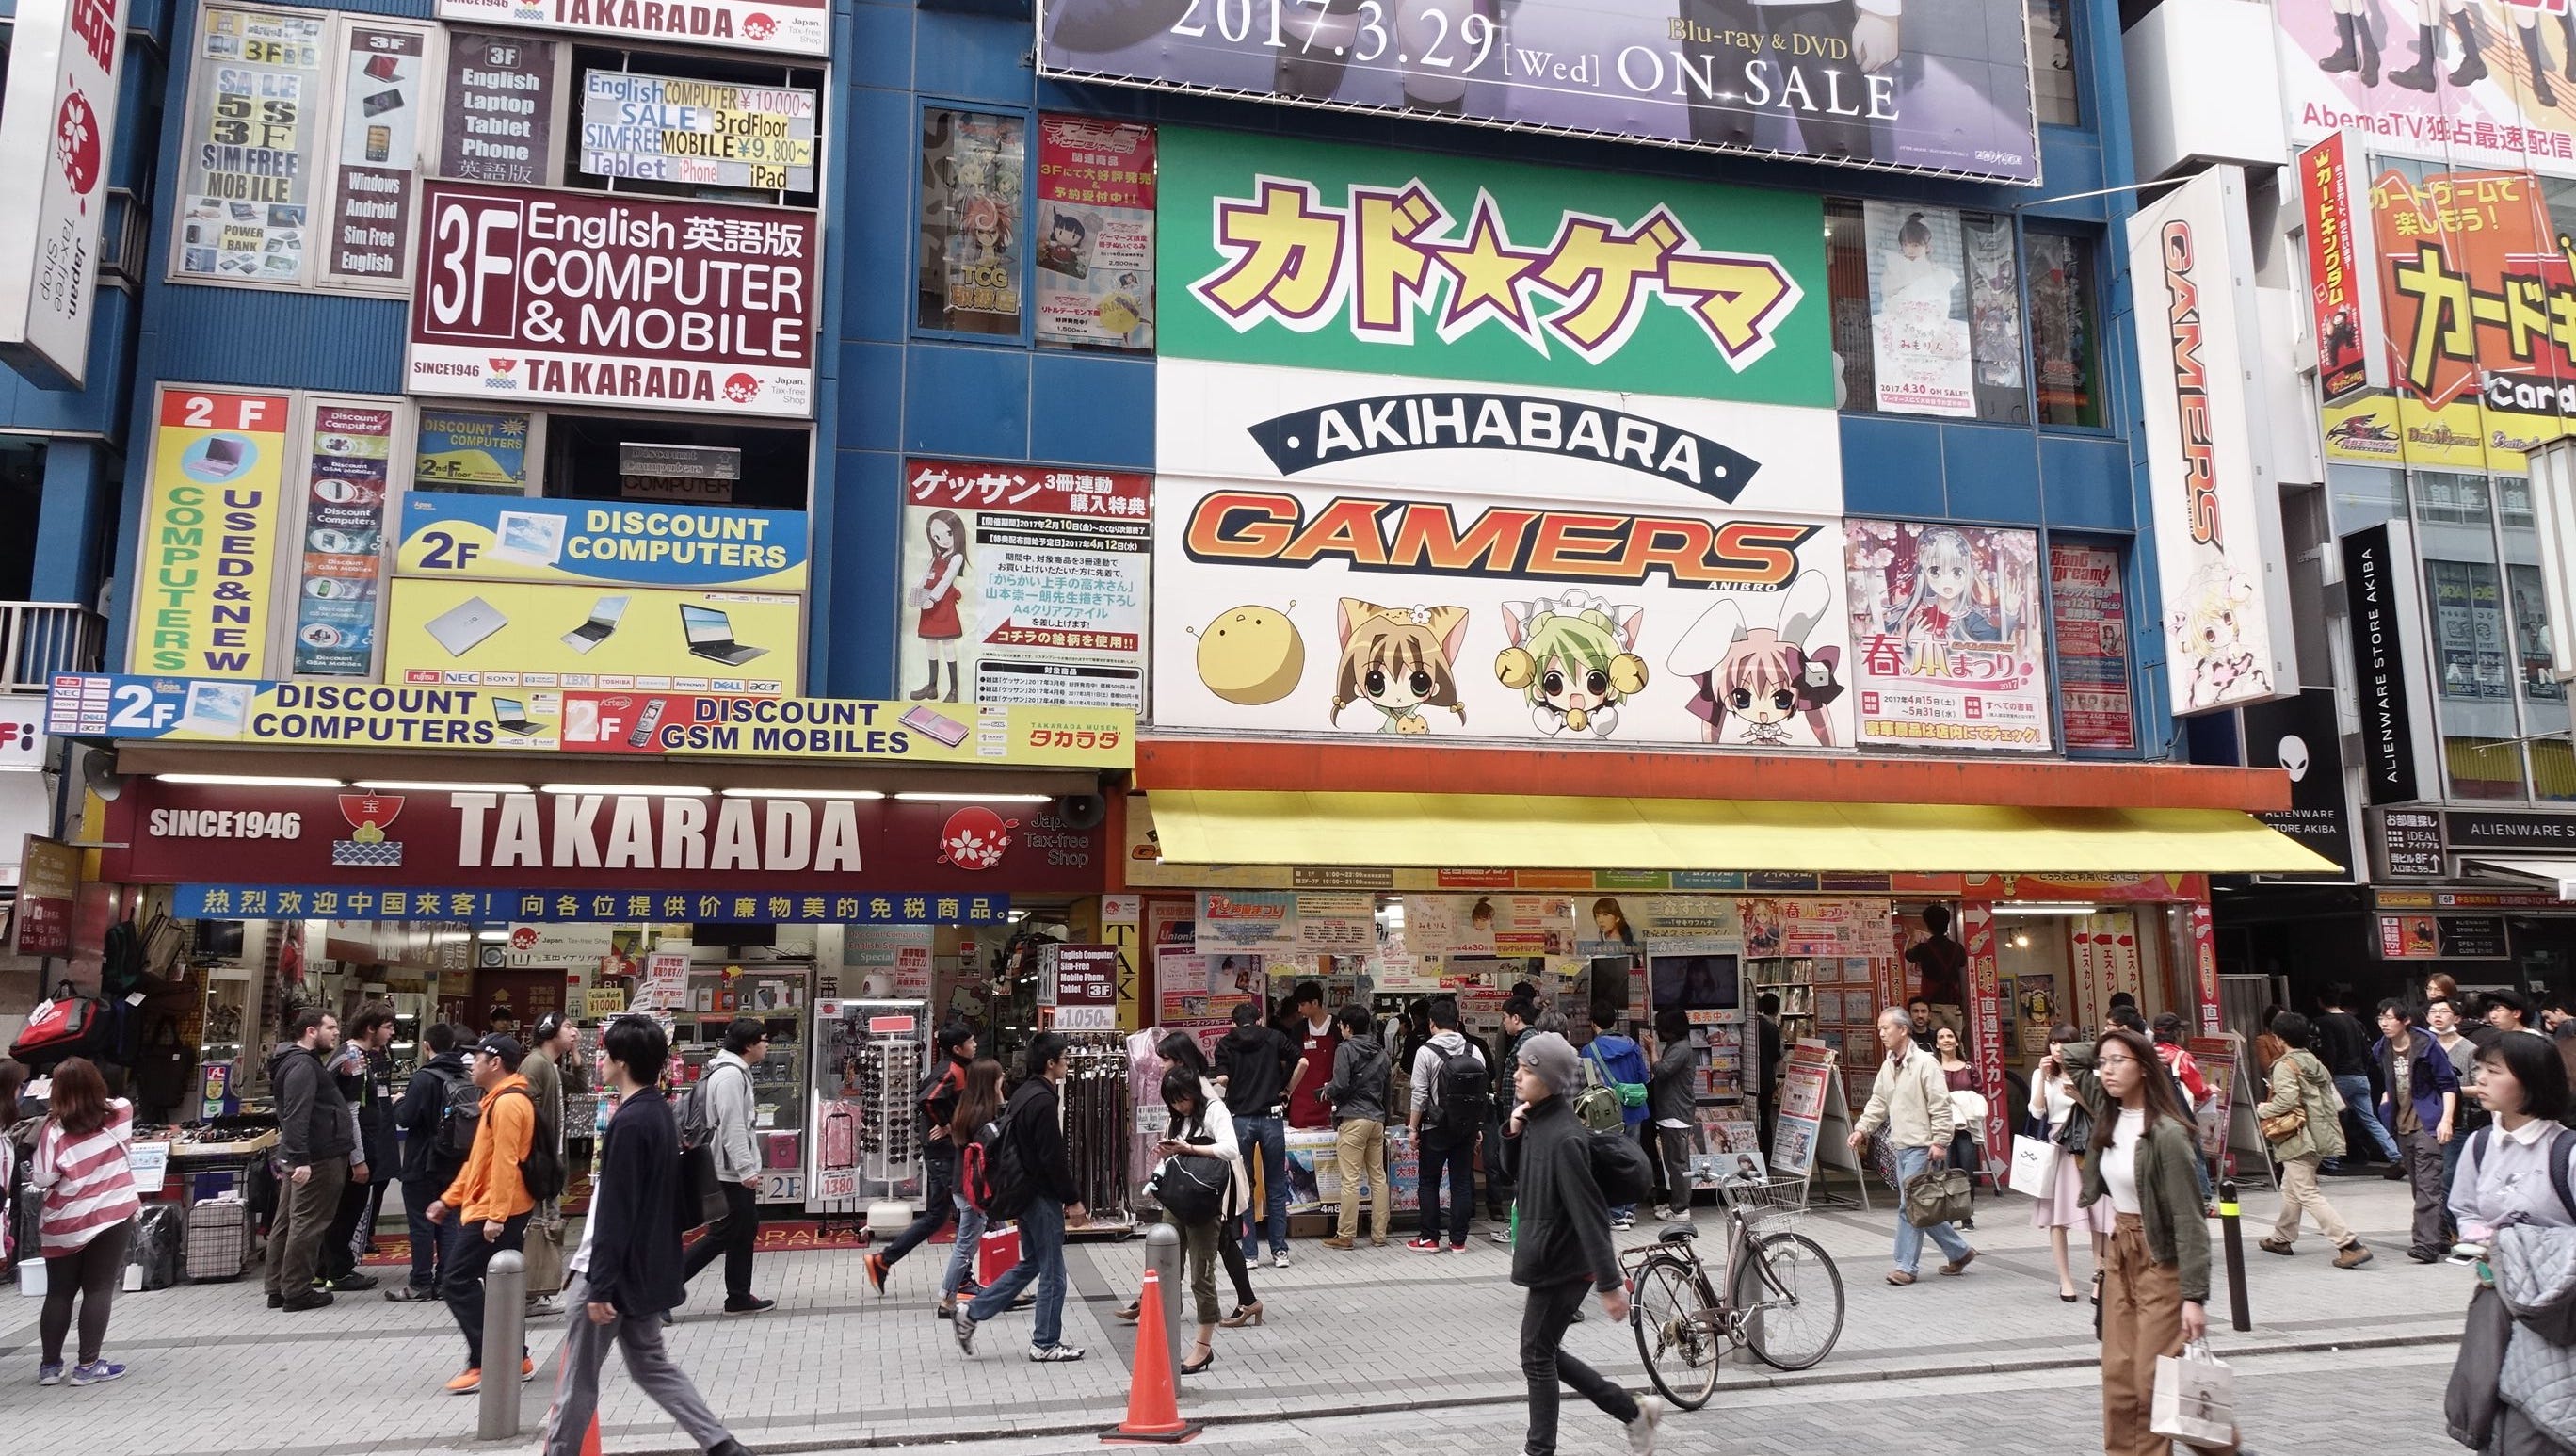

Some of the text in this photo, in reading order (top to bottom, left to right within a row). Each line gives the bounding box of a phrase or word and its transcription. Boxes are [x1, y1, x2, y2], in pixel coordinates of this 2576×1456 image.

[554, 0, 734, 39] TAKARADA
[791, 17, 822, 27] Japan.
[369, 35, 407, 50] 3F
[789, 26, 821, 38] Tax-free
[799, 35, 822, 45] Shop
[1667, 16, 1848, 60] Blu-ray & DVD
[489, 45, 516, 65] 3F
[218, 69, 298, 97] SALE
[462, 67, 539, 92] English
[1504, 43, 1600, 87] [Wed]
[1617, 44, 1716, 100] ON
[1744, 58, 1901, 122] SALE
[463, 90, 535, 117] Laptop
[588, 73, 738, 111] English COMPUTER
[464, 115, 531, 138] Tablet
[621, 104, 789, 138] SALE 3rd Floor
[462, 138, 529, 161] Phone
[661, 134, 735, 158] MOBILE
[457, 159, 533, 185] 英語版
[589, 152, 787, 189] Tablet iPhone iPad
[205, 172, 289, 203] MOBILE
[348, 171, 401, 194] Windows
[2368, 178, 2520, 211] カードゲームで
[346, 198, 398, 220] Android
[224, 223, 264, 238] POWER
[344, 225, 395, 248] Sim Free
[527, 202, 804, 258] English 英語版
[2315, 168, 2345, 308] カードキングダム
[226, 238, 258, 253] BANK
[40, 238, 61, 302] Shop
[341, 251, 394, 274] English
[431, 202, 520, 328] 3F
[523, 246, 802, 314] COMPUTER
[961, 264, 1008, 288] TCG
[522, 299, 803, 359] & MOBILE
[413, 361, 480, 378] SINCE1946
[523, 358, 716, 402] TAKARADA
[770, 386, 807, 397] Tax-free
[774, 376, 806, 387] Japan.
[1879, 382, 1926, 396] 2017.4.30
[1929, 387, 1942, 396] ON
[2161, 218, 2224, 555] GAMERS
[782, 395, 807, 406] Shop
[324, 420, 383, 431] Computers
[330, 412, 378, 423] Discount
[424, 419, 494, 437] DISCOUNT
[449, 434, 523, 449] COMPUTERS
[1315, 397, 1702, 484] AKIHABARA
[911, 467, 1114, 506] ゲッサン 3冊連動
[323, 507, 371, 517] Discount
[1070, 493, 1147, 517] 購入特典
[316, 515, 376, 526] Computers
[586, 510, 770, 541] DISCOUNT
[418, 531, 481, 570] 2F
[1183, 490, 1821, 591] GAMERS
[567, 537, 788, 569] COMPUTERS
[152, 486, 205, 671] COMPUTERS
[1707, 580, 1779, 593] ANIBRO
[1012, 604, 1108, 620] A4クリアファイル
[315, 654, 353, 662] Discount
[2360, 547, 2399, 784] ALIENWARE STORE AKIBA
[444, 671, 479, 684] NEC
[486, 673, 517, 684] SONY
[565, 674, 592, 686] IBM
[713, 680, 742, 691] DELL
[2000, 679, 2019, 691] 2017
[54, 688, 80, 699] NEC
[275, 683, 480, 715] DISCOUNT
[109, 684, 177, 730] 2F
[693, 698, 880, 726] DISCOUNT
[252, 712, 495, 745] COMPUTERS
[1030, 721, 1119, 732] TAKARADA MUSEN
[660, 725, 910, 754] GSM MOBILES
[1029, 730, 1121, 751] タカラダ
[149, 808, 301, 840] SINCE1946
[2264, 807, 2336, 819] ALIENWARE
[2385, 814, 2438, 827] お部屋探し
[450, 792, 863, 873] TAKARADA
[1024, 831, 1090, 849] Tax-free
[2304, 823, 2338, 834] AKIBA
[2407, 831, 2439, 842] iDEAL
[2470, 822, 2563, 837] ALIENWARE
[1047, 849, 1090, 868] Shop
[847, 942, 881, 951] English
[860, 952, 894, 963] Special
[1060, 950, 1115, 960] English Computer
[1060, 962, 1090, 971] Sim-Free
[1106, 924, 1136, 1001] TAX
[1060, 973, 1105, 982] Mobile Phone
[1060, 983, 1110, 997] Tablet 3F
[589, 998, 621, 1011] ¥1000!
[1979, 995, 2007, 1152] 直通エスカレーター
